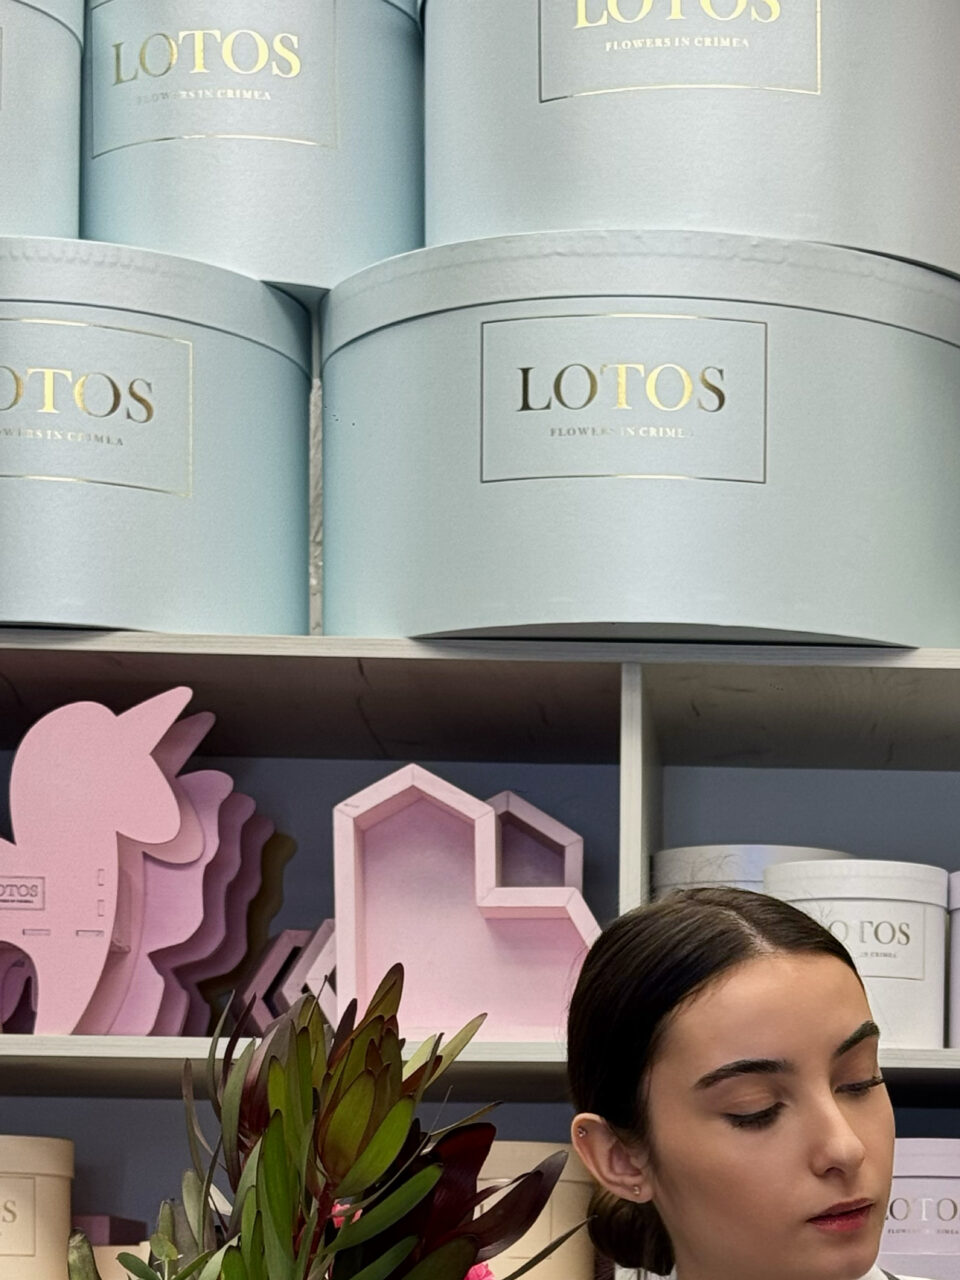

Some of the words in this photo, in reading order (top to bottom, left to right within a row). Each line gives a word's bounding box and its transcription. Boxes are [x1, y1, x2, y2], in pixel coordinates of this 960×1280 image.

[111, 29, 301, 87] LOTOS
[606, 38, 671, 52] FLOWERS
[674, 37, 690, 48] IN
[694, 37, 750, 48] CRIMEA
[217, 88, 272, 101] CRIMEA
[0, 365, 154, 424] OTOS
[516, 363, 726, 413] LOTOS
[828, 919, 911, 946] OTOS
